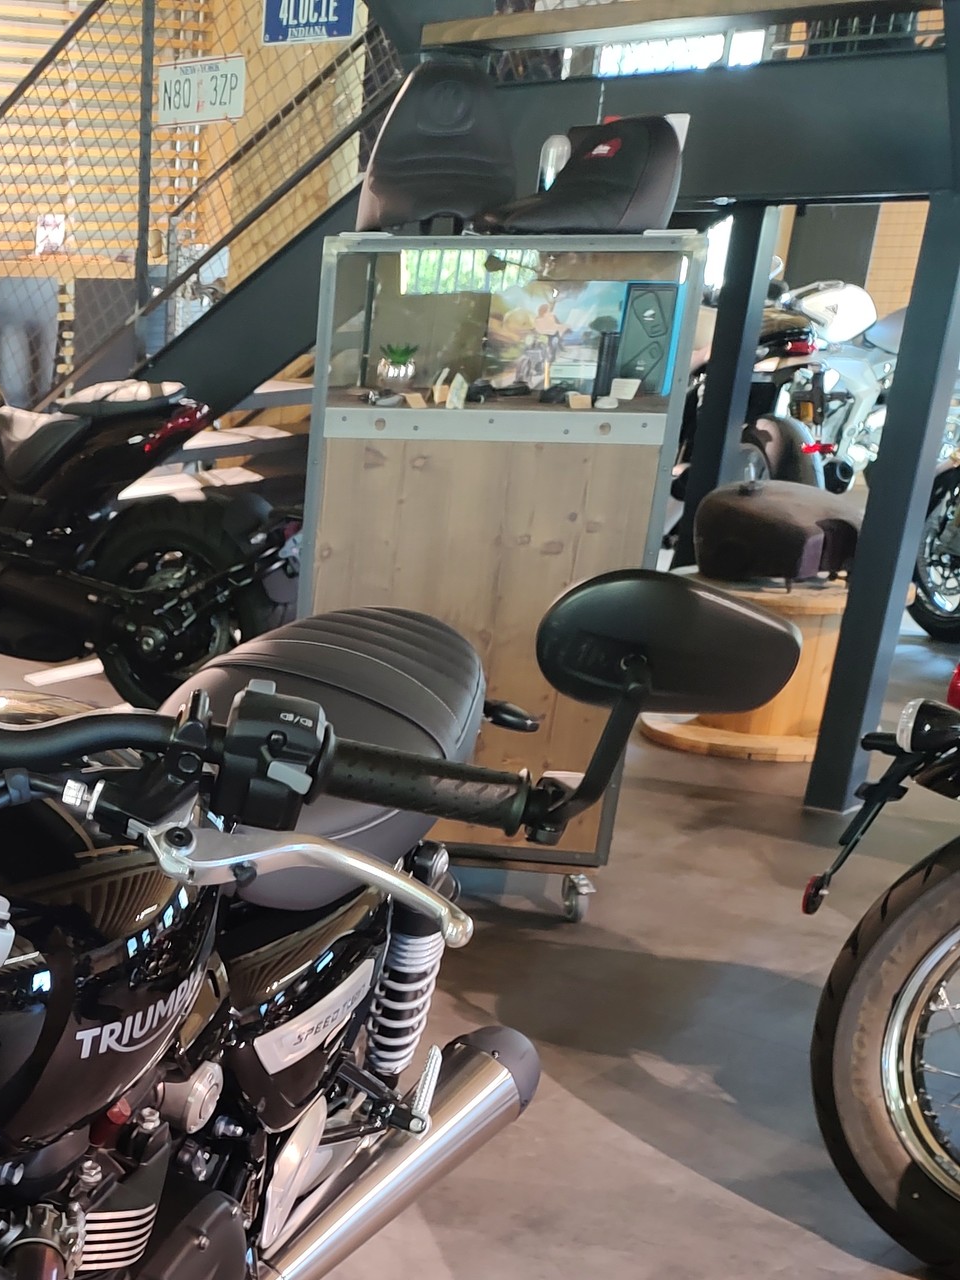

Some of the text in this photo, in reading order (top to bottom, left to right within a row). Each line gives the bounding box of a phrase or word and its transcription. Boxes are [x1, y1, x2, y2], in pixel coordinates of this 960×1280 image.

[288, 25, 327, 38] INDIANA
[162, 78, 192, 111] N80
[292, 1007, 340, 1046] SPEED
